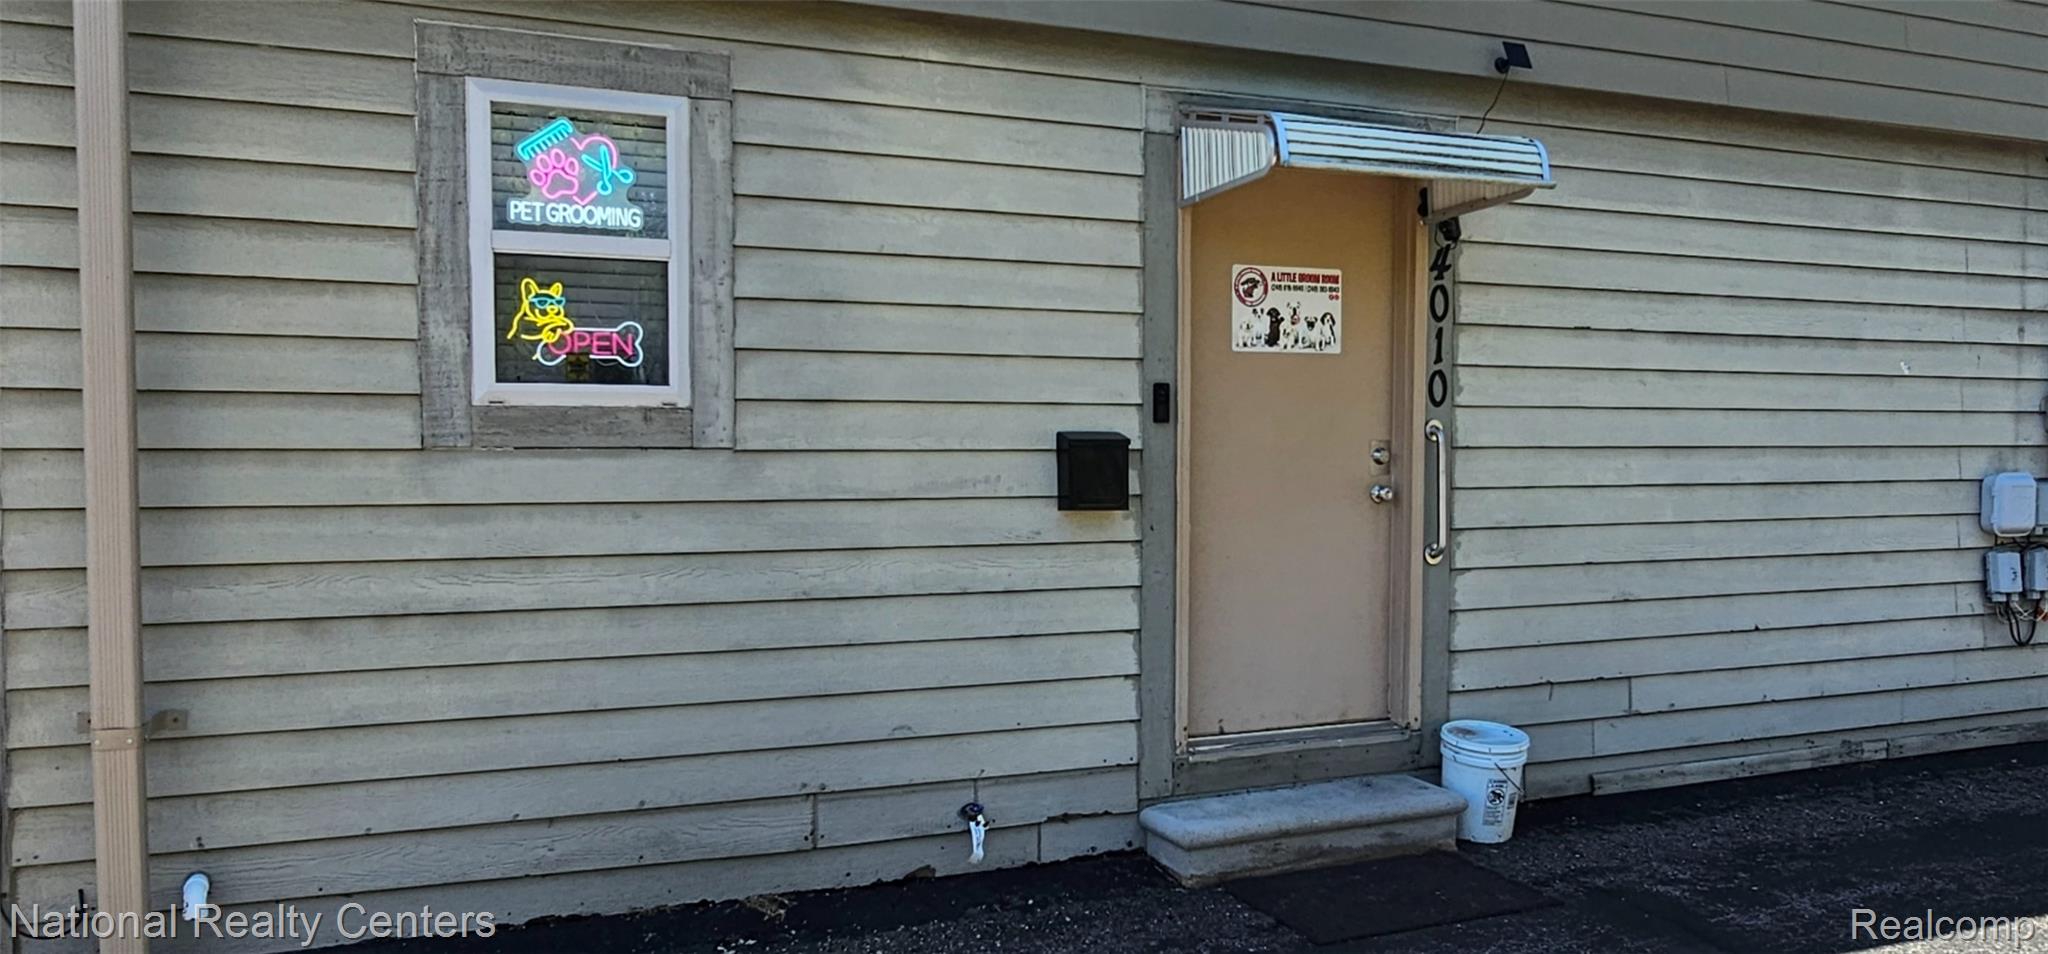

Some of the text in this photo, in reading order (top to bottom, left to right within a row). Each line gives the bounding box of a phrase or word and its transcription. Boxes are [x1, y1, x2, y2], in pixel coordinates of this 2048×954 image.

[510, 200, 643, 228] PET GROOMING
[1271, 272, 1276, 282] A
[1276, 272, 1297, 283] LITTLE
[1428, 243, 1452, 408] 4010
[547, 331, 635, 357] OPEN
